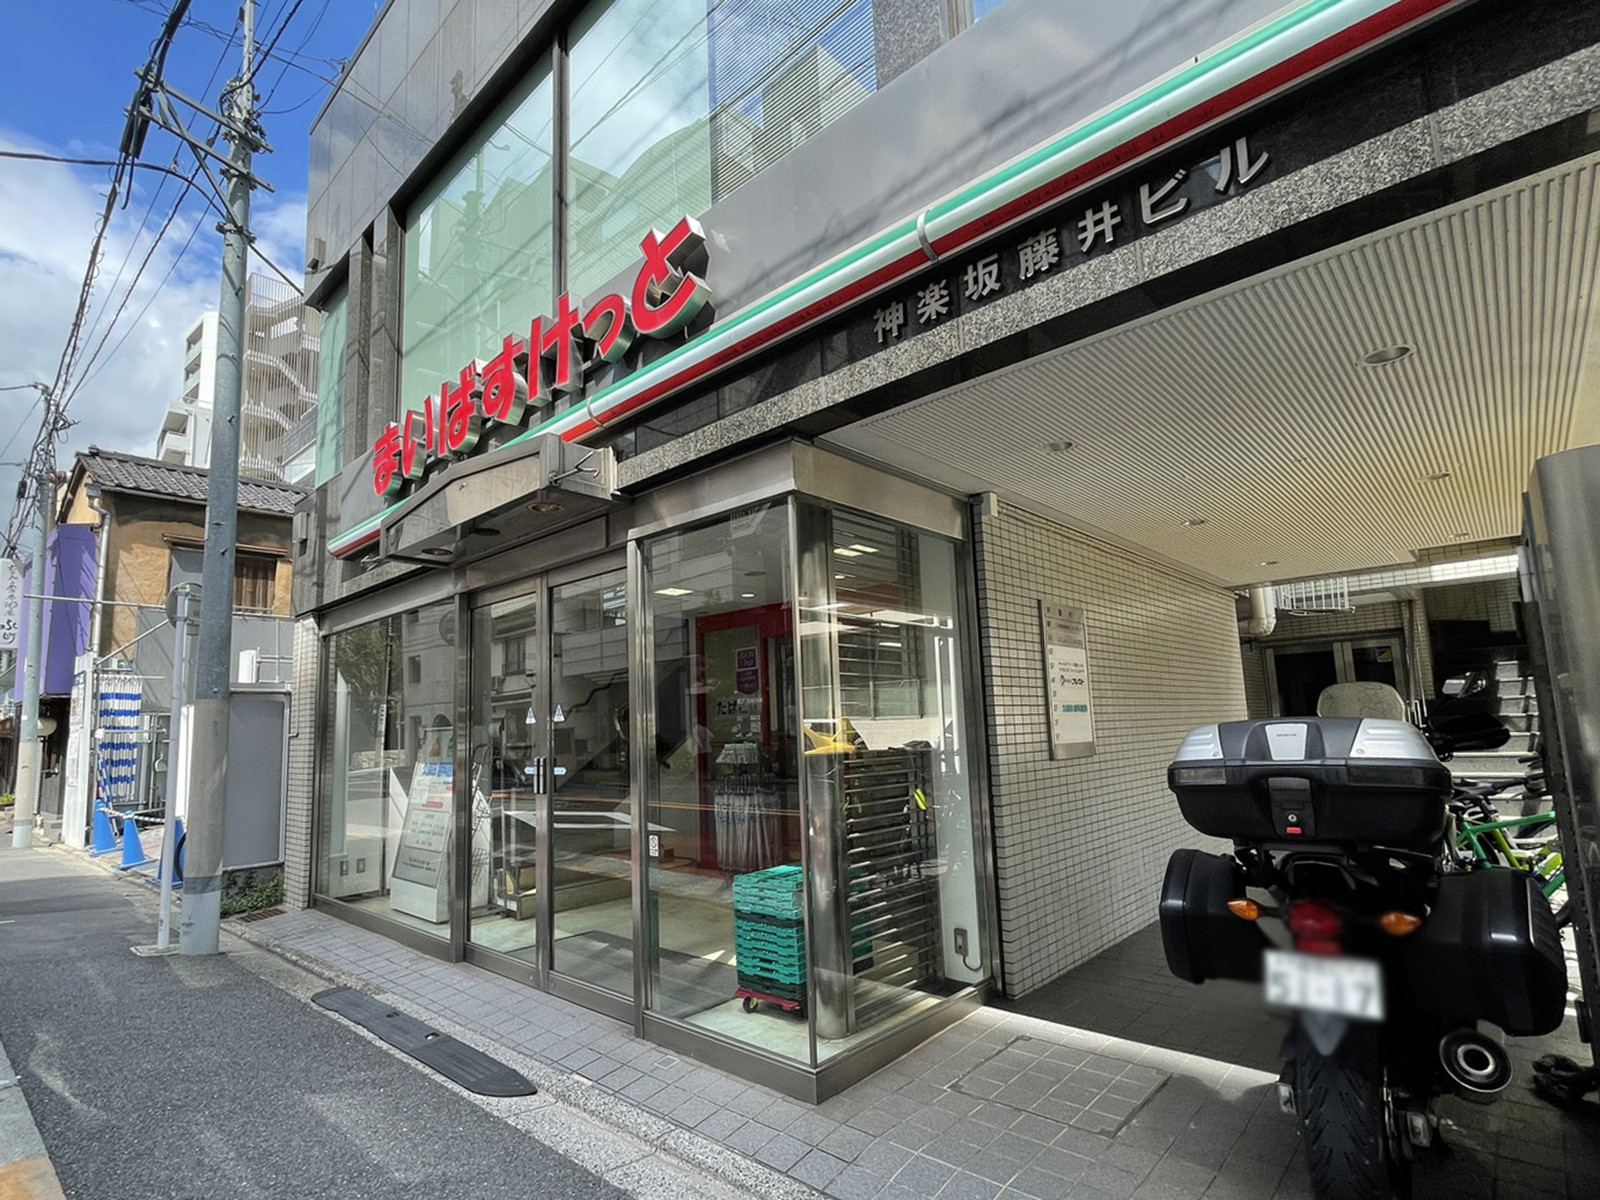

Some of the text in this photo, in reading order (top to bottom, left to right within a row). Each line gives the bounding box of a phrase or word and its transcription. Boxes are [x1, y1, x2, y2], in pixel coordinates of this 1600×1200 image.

[373, 215, 706, 497] まいばすけっと
[873, 136, 1270, 343] 神楽坂藤井ビル
